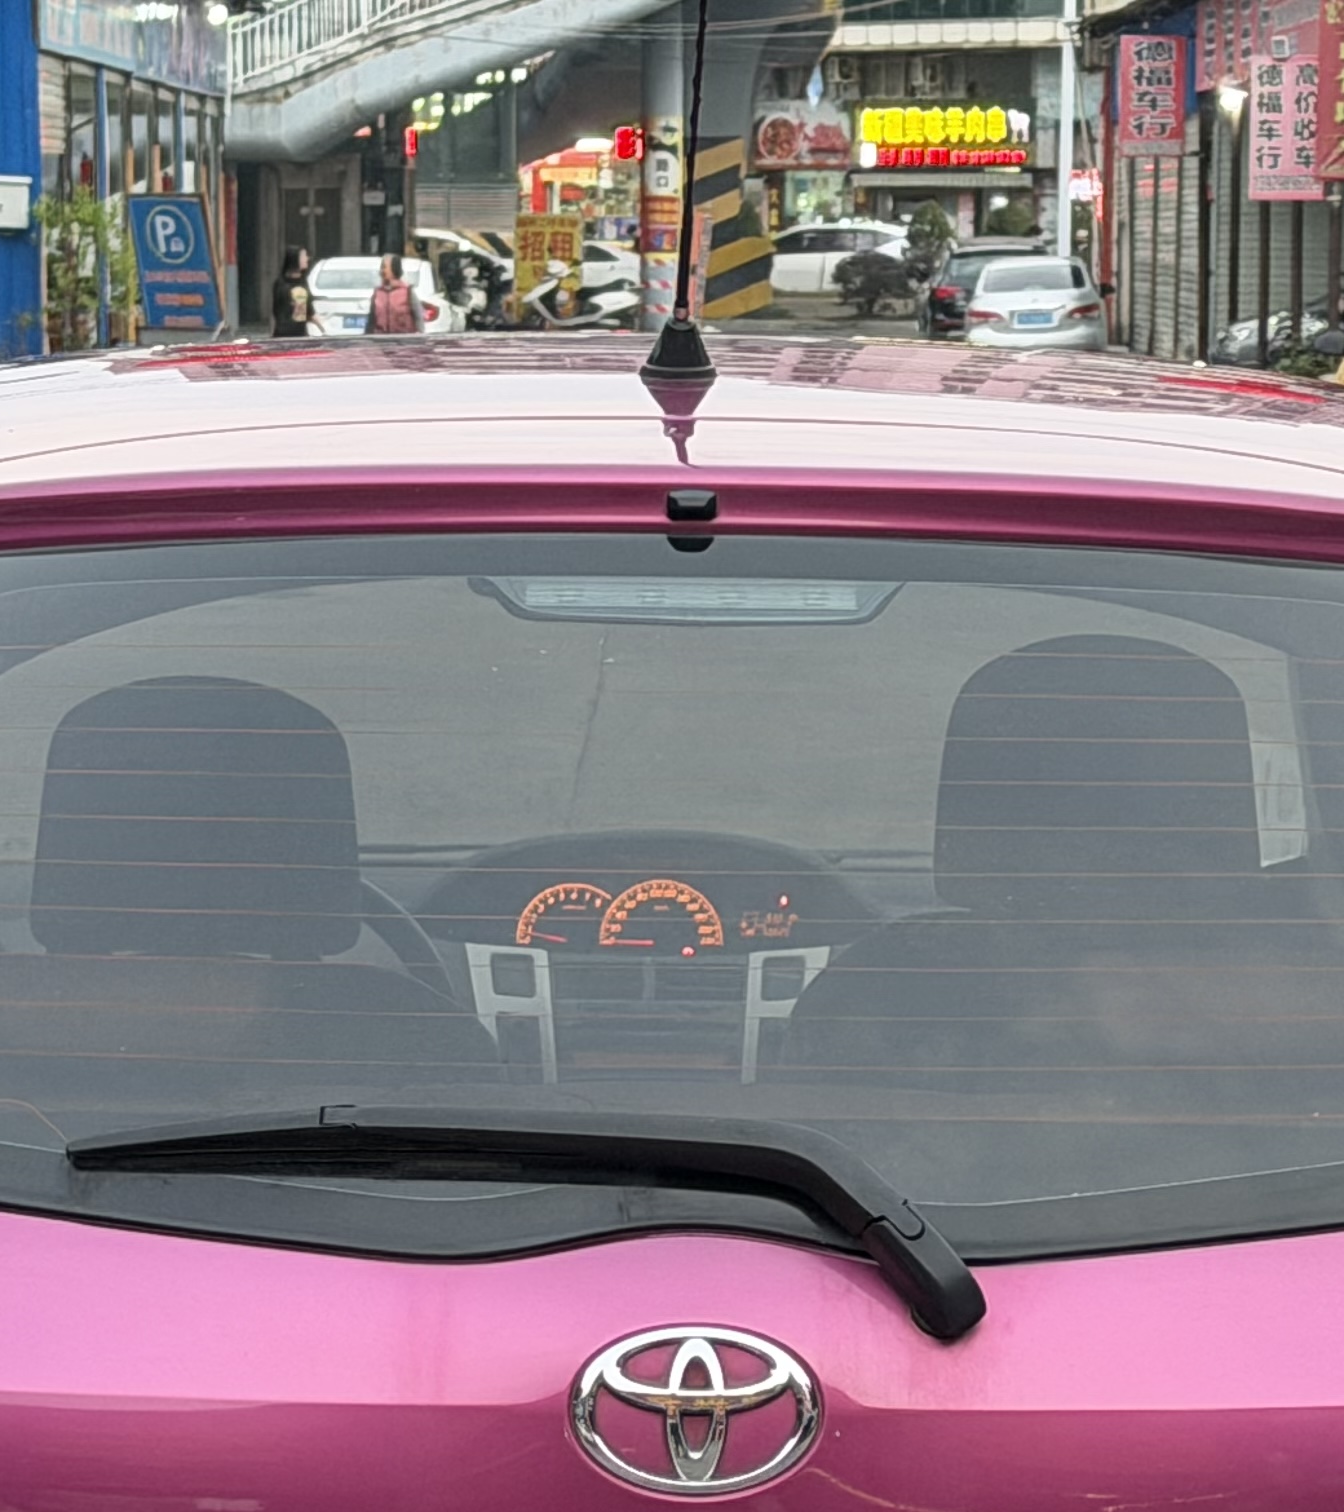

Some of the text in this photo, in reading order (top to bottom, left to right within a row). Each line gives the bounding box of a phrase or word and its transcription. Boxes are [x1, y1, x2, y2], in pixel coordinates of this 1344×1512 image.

[1131, 41, 1175, 137] 德福车行
[1256, 64, 1284, 169] 德福车行
[1293, 64, 1319, 169] 高价收车
